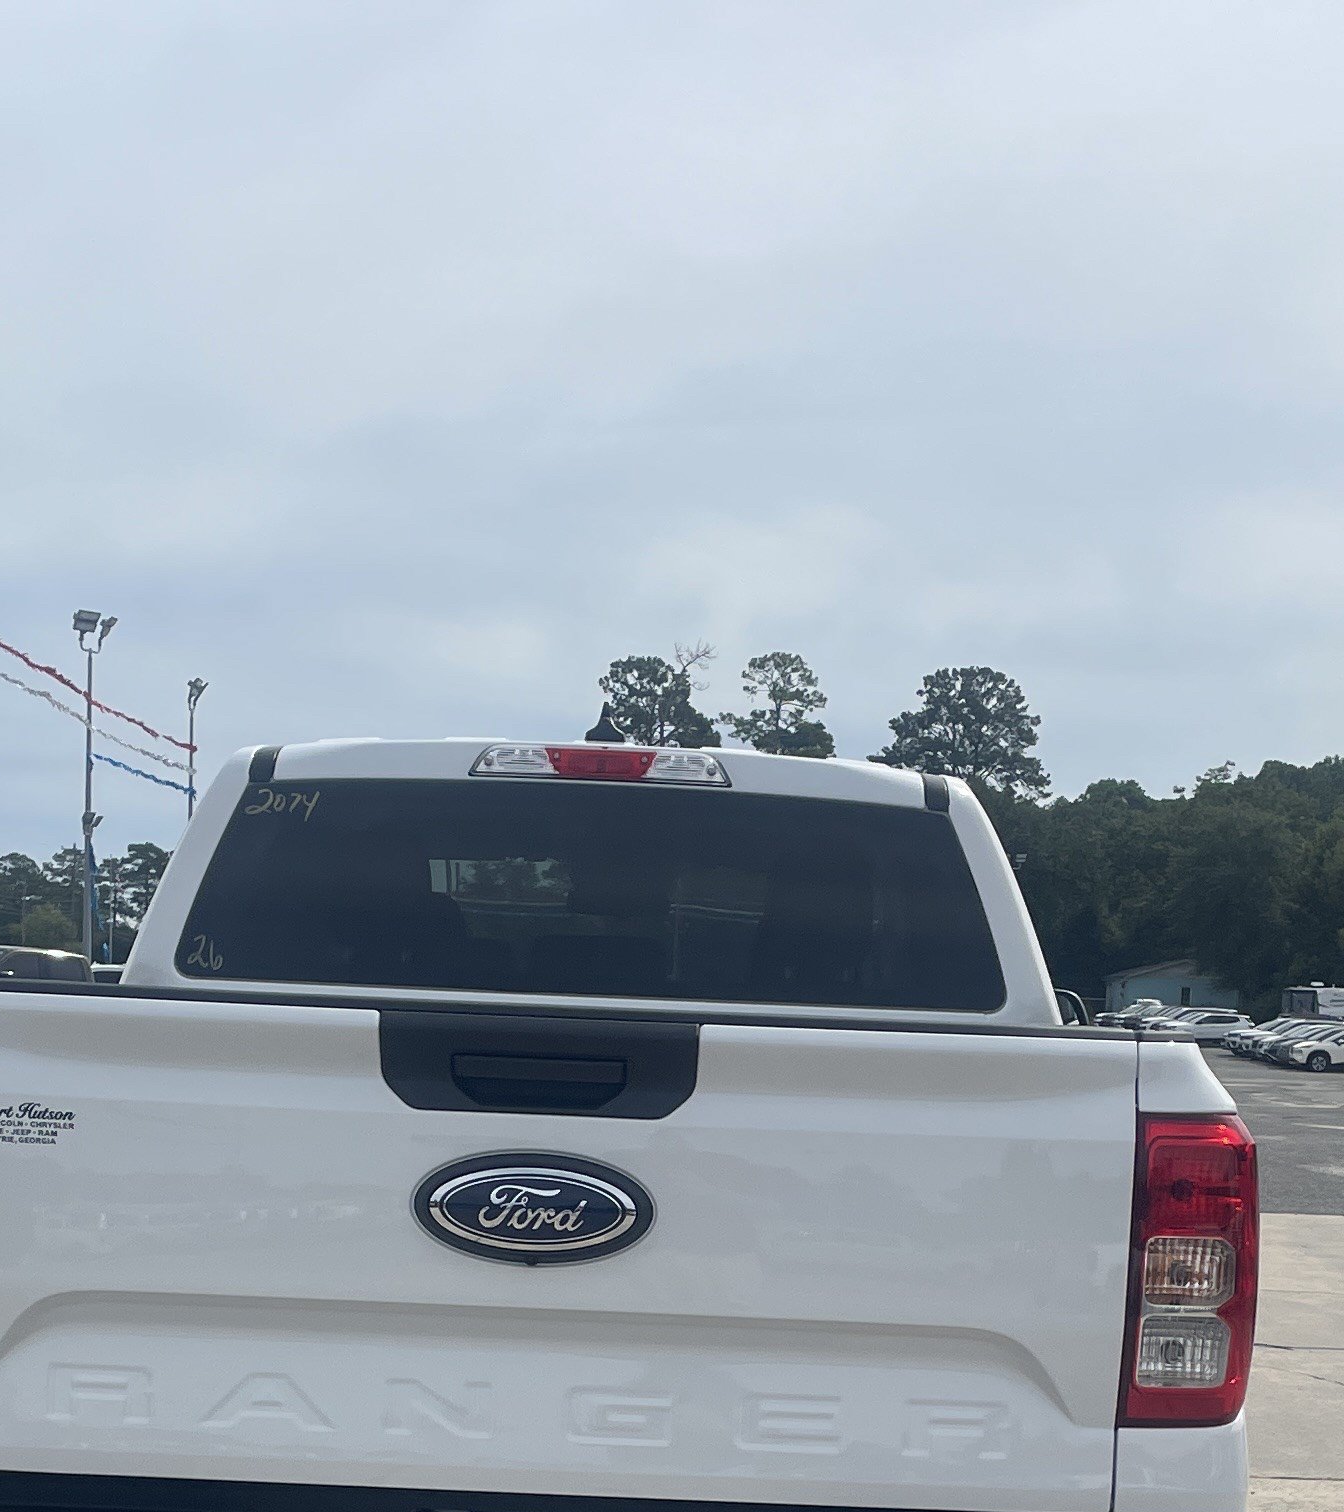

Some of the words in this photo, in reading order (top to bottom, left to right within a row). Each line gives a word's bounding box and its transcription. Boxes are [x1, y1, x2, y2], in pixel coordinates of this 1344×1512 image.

[244, 788, 321, 822] 2074
[15, 1102, 76, 1121] Hutson
[11, 1128, 32, 1136] JEEP
[38, 1129, 58, 1137] RAM
[30, 1121, 75, 1130] CHRYSLER
[18, 1136, 56, 1145] GEORGIA
[478, 1184, 588, 1232] Ford
[45, 1361, 1014, 1461] RANGER
